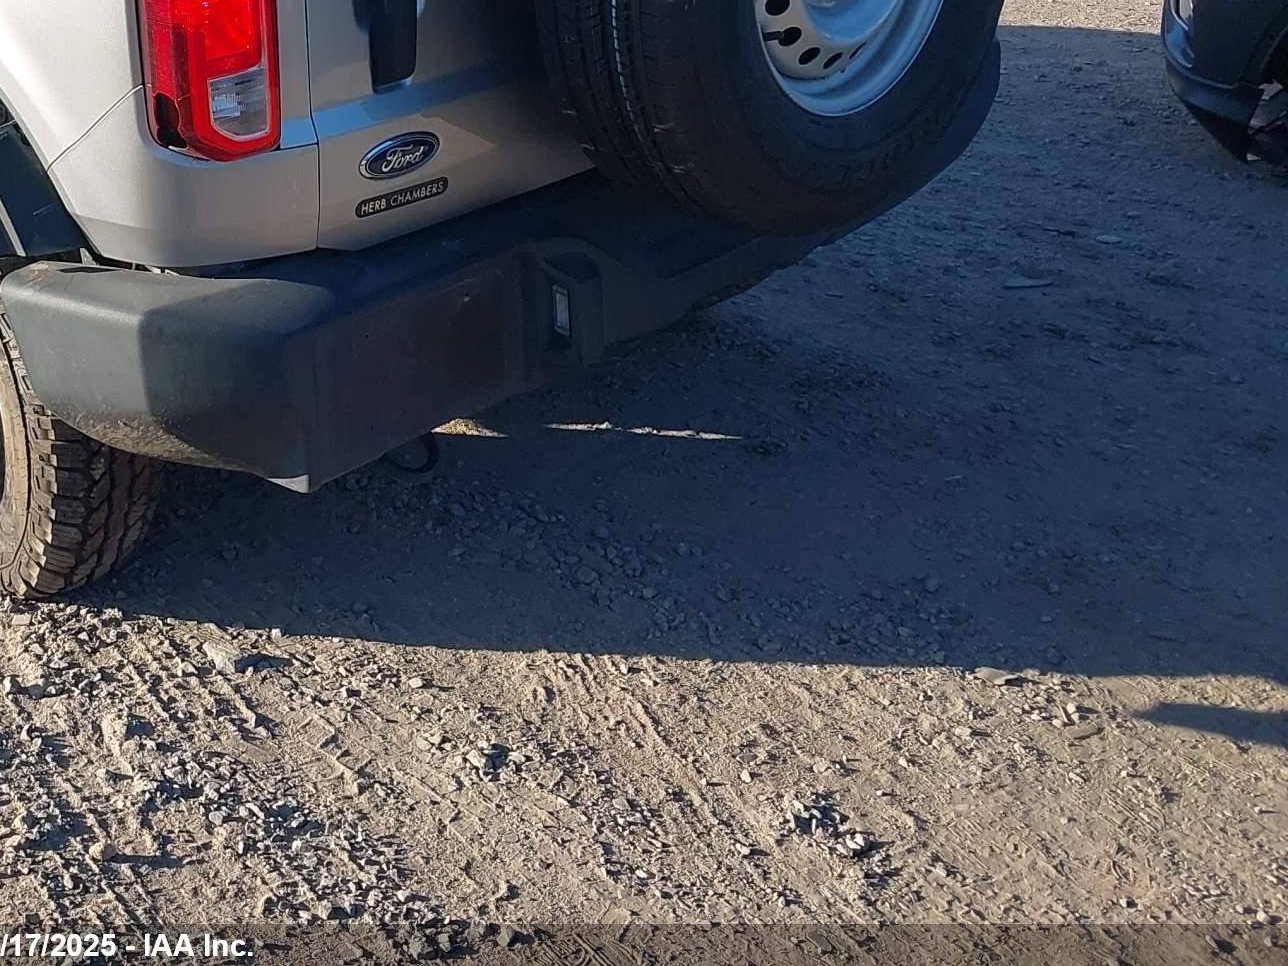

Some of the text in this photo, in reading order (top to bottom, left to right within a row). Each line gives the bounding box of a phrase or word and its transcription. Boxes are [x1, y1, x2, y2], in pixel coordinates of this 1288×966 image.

[381, 144, 424, 172] Ford
[361, 182, 444, 215] HERB CHAMBERS
